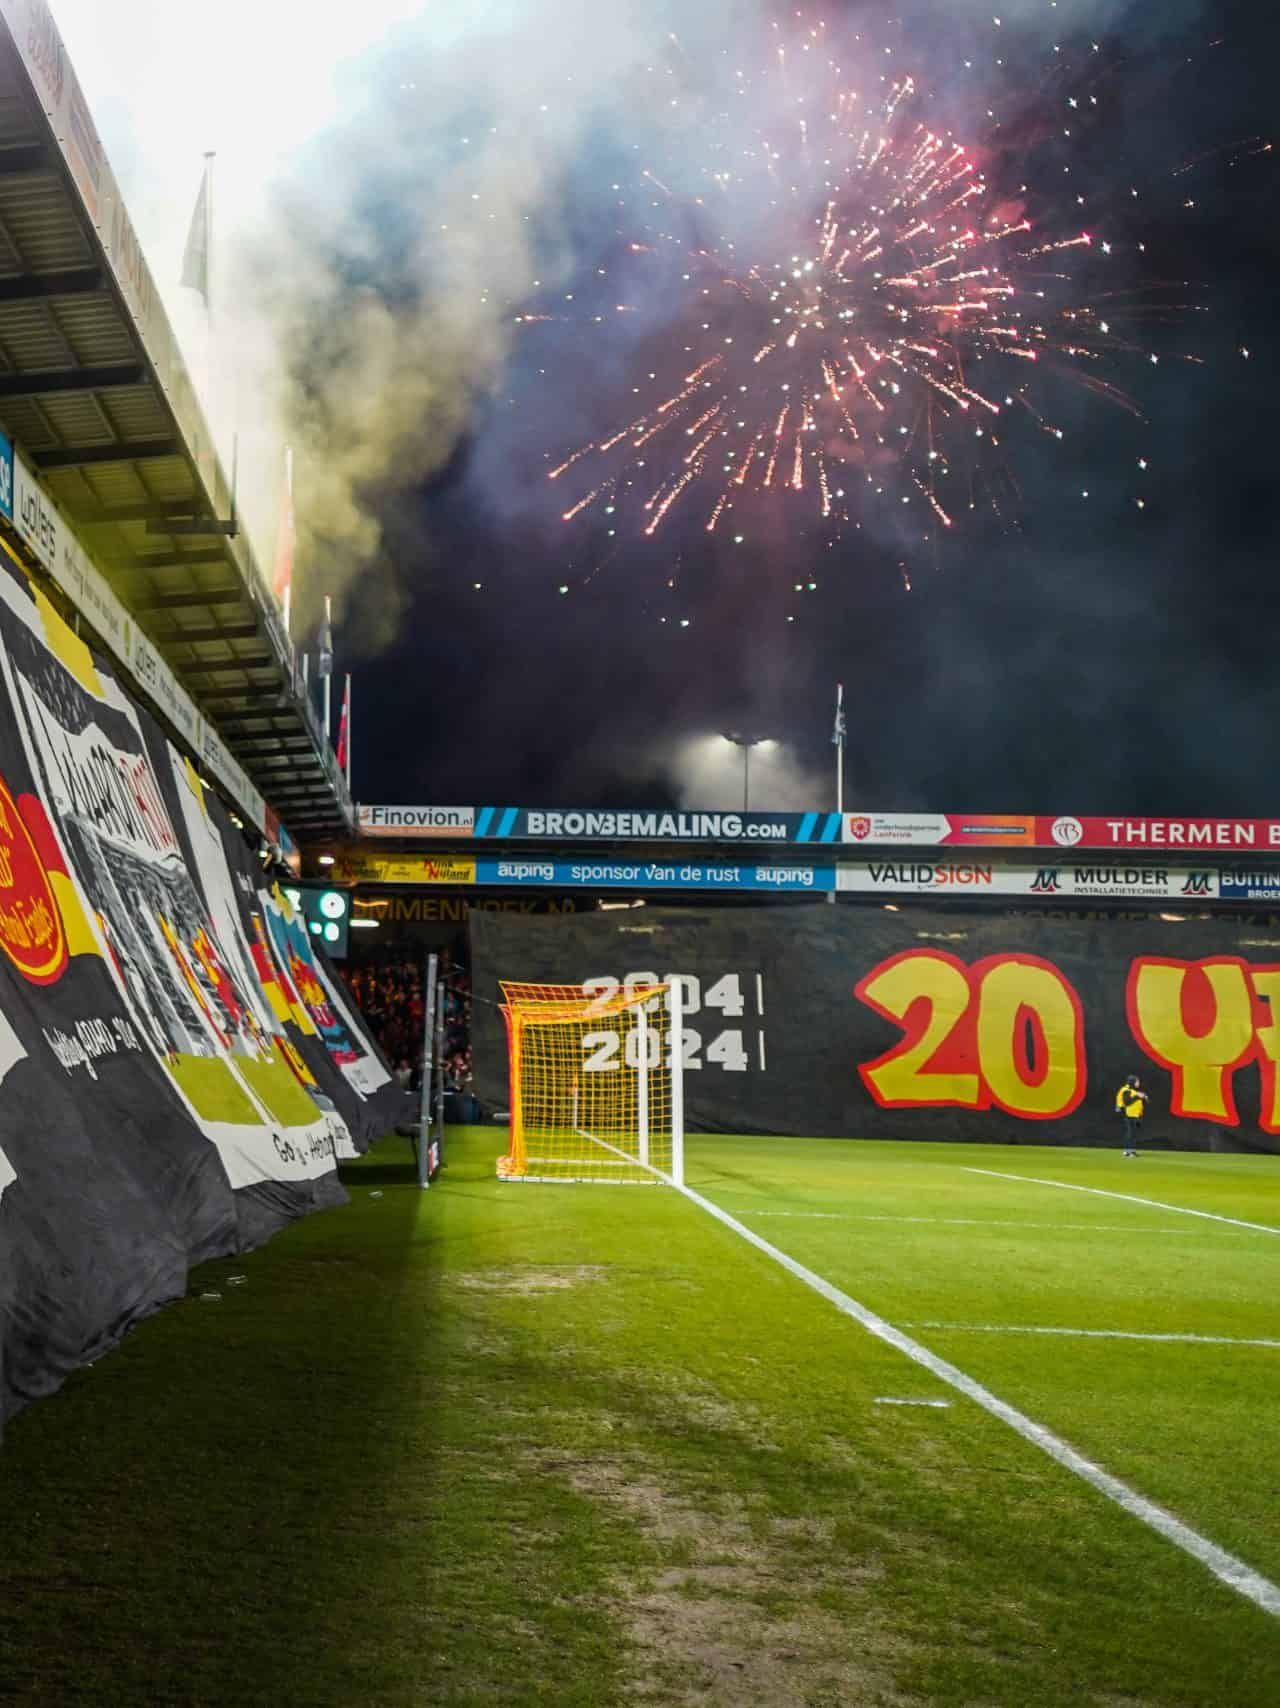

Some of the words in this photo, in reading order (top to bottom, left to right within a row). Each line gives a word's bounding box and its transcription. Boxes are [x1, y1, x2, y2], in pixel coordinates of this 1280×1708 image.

[1107, 822, 1255, 844] THERMEN
[497, 863, 554, 880] auping
[571, 865, 640, 882] sponsor
[644, 865, 675, 880] van
[680, 865, 702, 881] de
[706, 867, 741, 882] rust
[755, 868, 814, 886] auping
[868, 863, 993, 885] VALIDSIGN
[1074, 868, 1169, 885] MULDER
[581, 971, 745, 1017] 2004
[581, 1028, 749, 1072] 2024
[854, 947, 1088, 1121] 20
[1125, 955, 1280, 1136] Y
